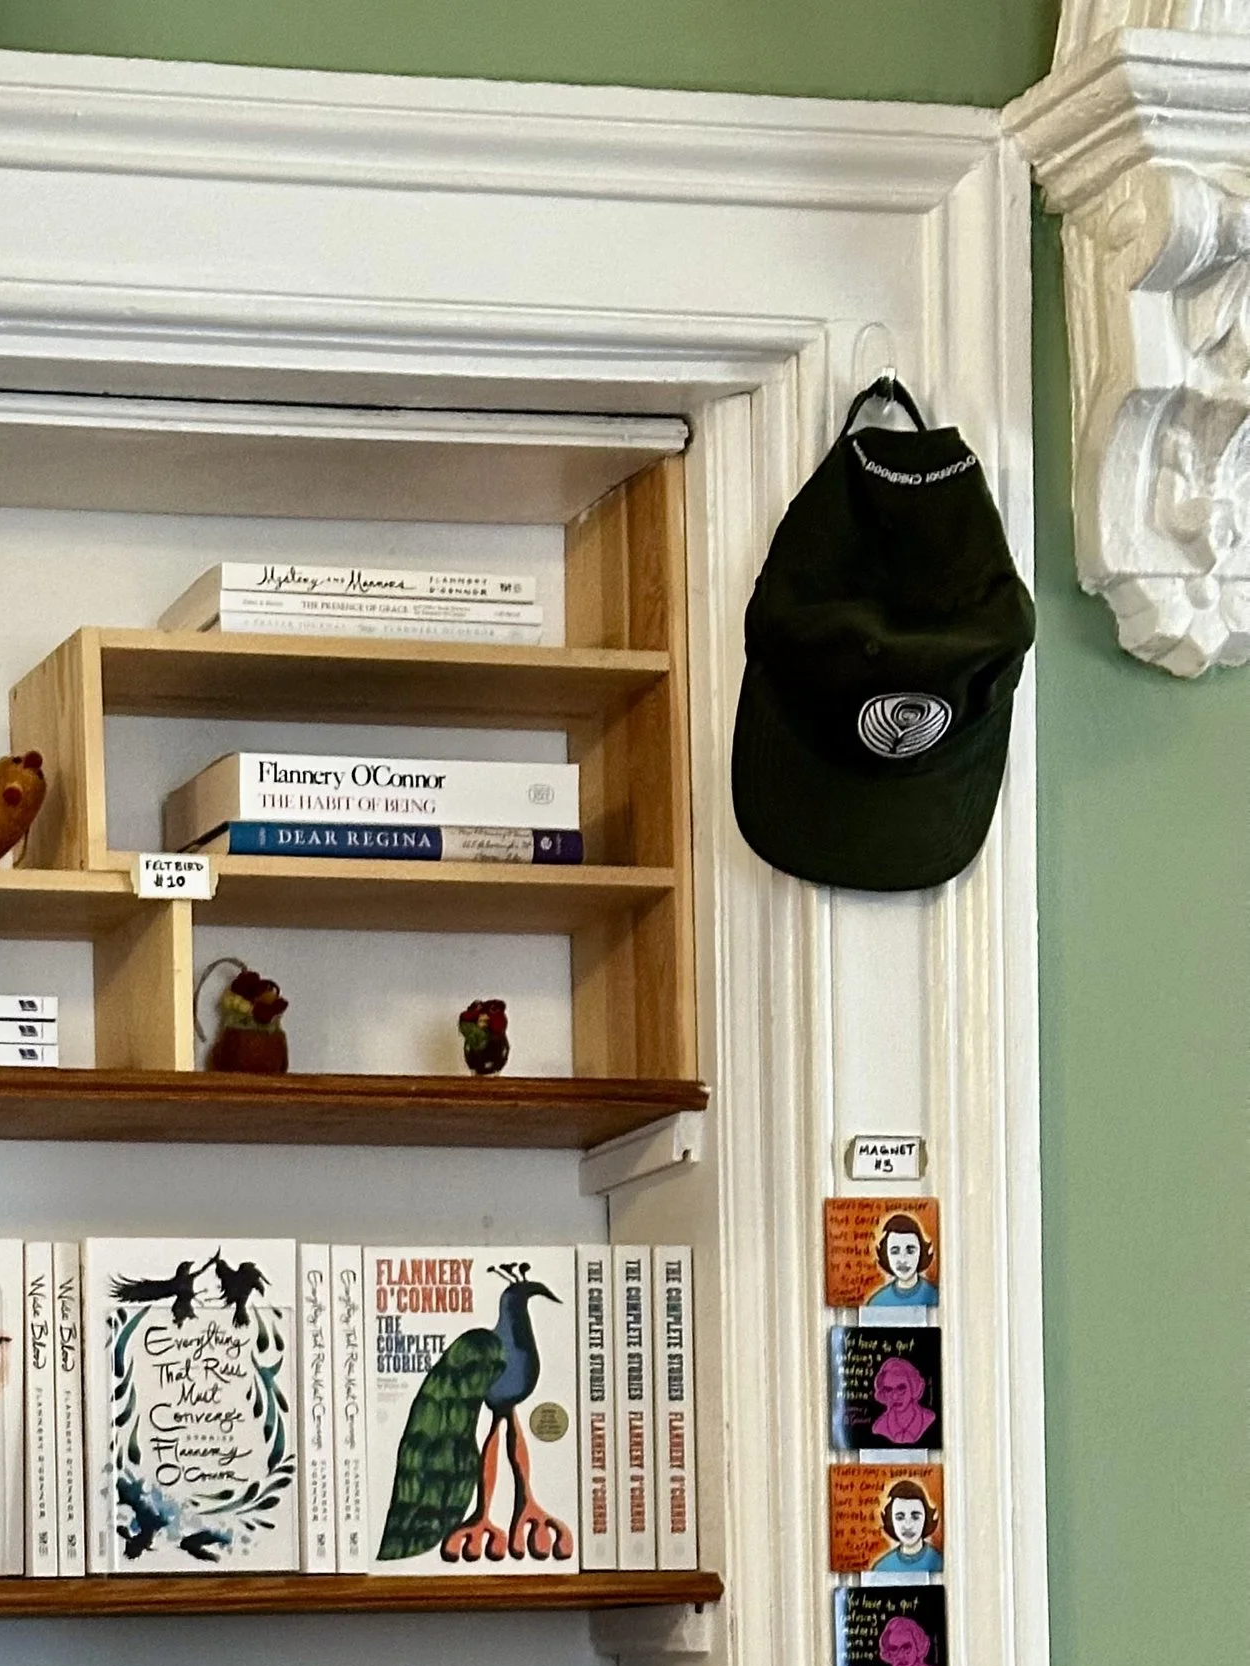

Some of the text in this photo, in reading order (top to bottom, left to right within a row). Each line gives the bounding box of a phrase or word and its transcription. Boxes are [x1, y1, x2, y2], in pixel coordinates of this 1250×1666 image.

[258, 760, 446, 790] Flannery O'Connor
[259, 793, 437, 815] THE HABIT OF BEING
[277, 828, 338, 846] DEAR
[347, 830, 432, 848] REGINA
[858, 1143, 916, 1156] MAGNET
[375, 1259, 474, 1285] FLANNERY
[376, 1286, 474, 1313] O'CONNOR
[376, 1316, 402, 1334] THE
[144, 1321, 250, 1360] Everything
[376, 1334, 446, 1354] COMPLETE
[152, 1357, 247, 1388] That Rises
[376, 1354, 433, 1373] STORIES
[587, 1262, 608, 1535] THE COMPLETE STORIES FLANNERY O'CONNOR
[666, 1260, 687, 1535] THE COMPLETE STORIES FLANNERY O'CONNOR
[149, 1403, 246, 1434] Converge
[151, 1438, 252, 1466] Flannery
[155, 1463, 249, 1486] O'Connor
